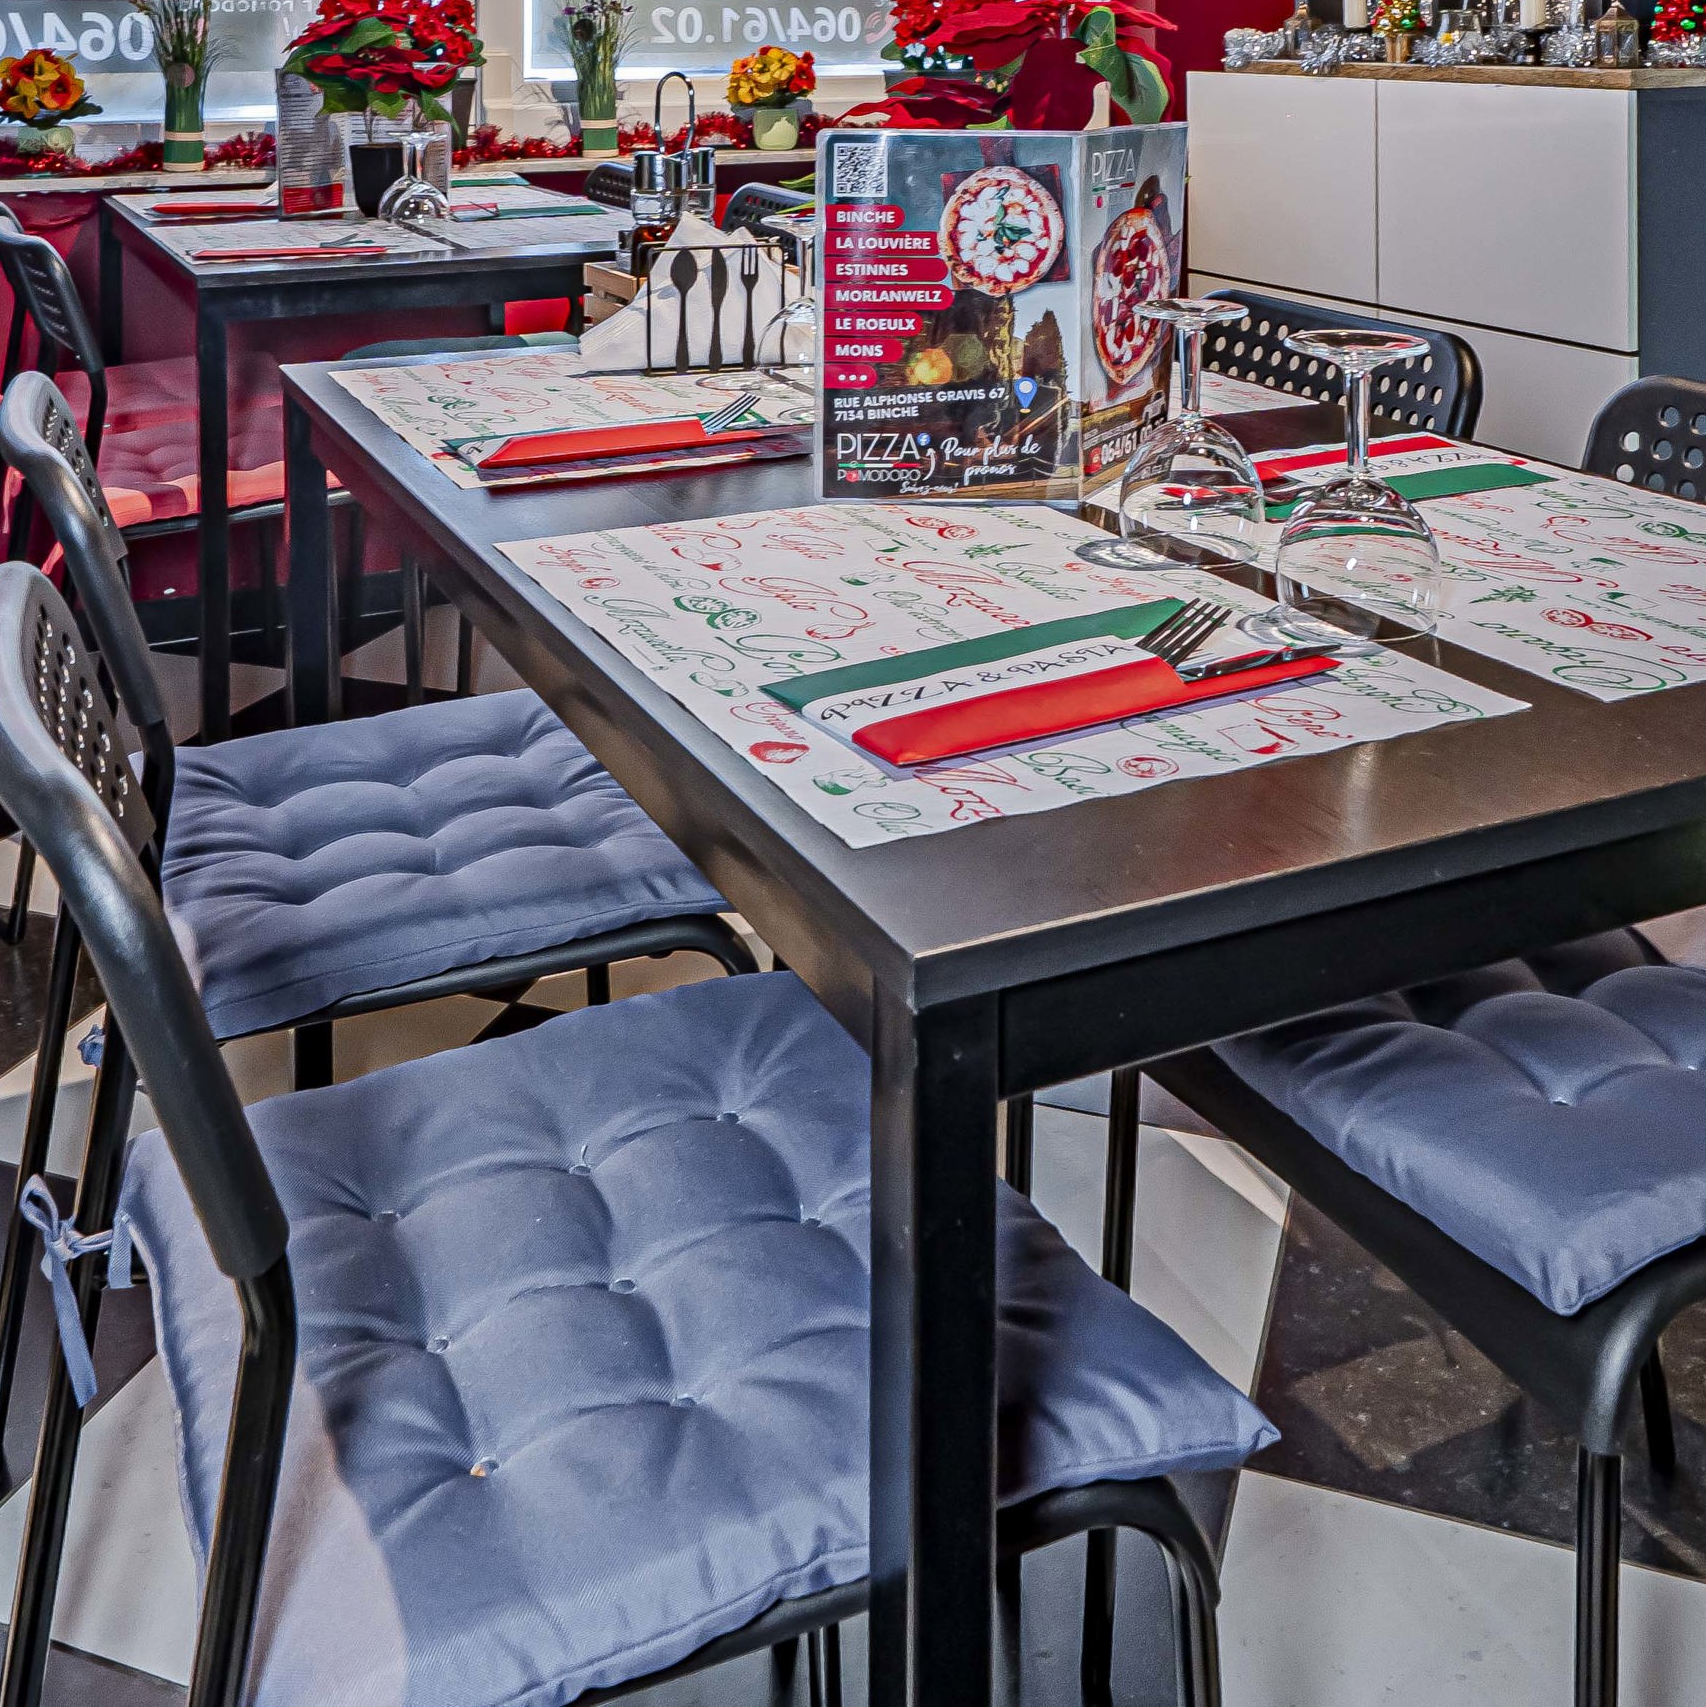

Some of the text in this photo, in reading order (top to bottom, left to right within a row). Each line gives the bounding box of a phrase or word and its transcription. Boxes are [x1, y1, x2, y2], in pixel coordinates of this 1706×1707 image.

[1092, 148, 1135, 183] PIZZA
[836, 210, 896, 223] BINCHE
[835, 233, 932, 250] LA LOUVIÈRE
[835, 263, 909, 276] ESTINNES
[835, 289, 943, 303] MORLANWELZ
[835, 317, 916, 331] LE ROEULX
[835, 344, 884, 357] MONS
[834, 387, 1009, 409] RUE ALPHONSE GRAVIS 67,
[834, 406, 920, 422] 7134 BINCHE
[836, 433, 921, 461] PIZZA
[940, 434, 1042, 466] Pour plus de
[836, 469, 921, 481] POMODORO
[819, 642, 1133, 722] PIZZA & PASTA
